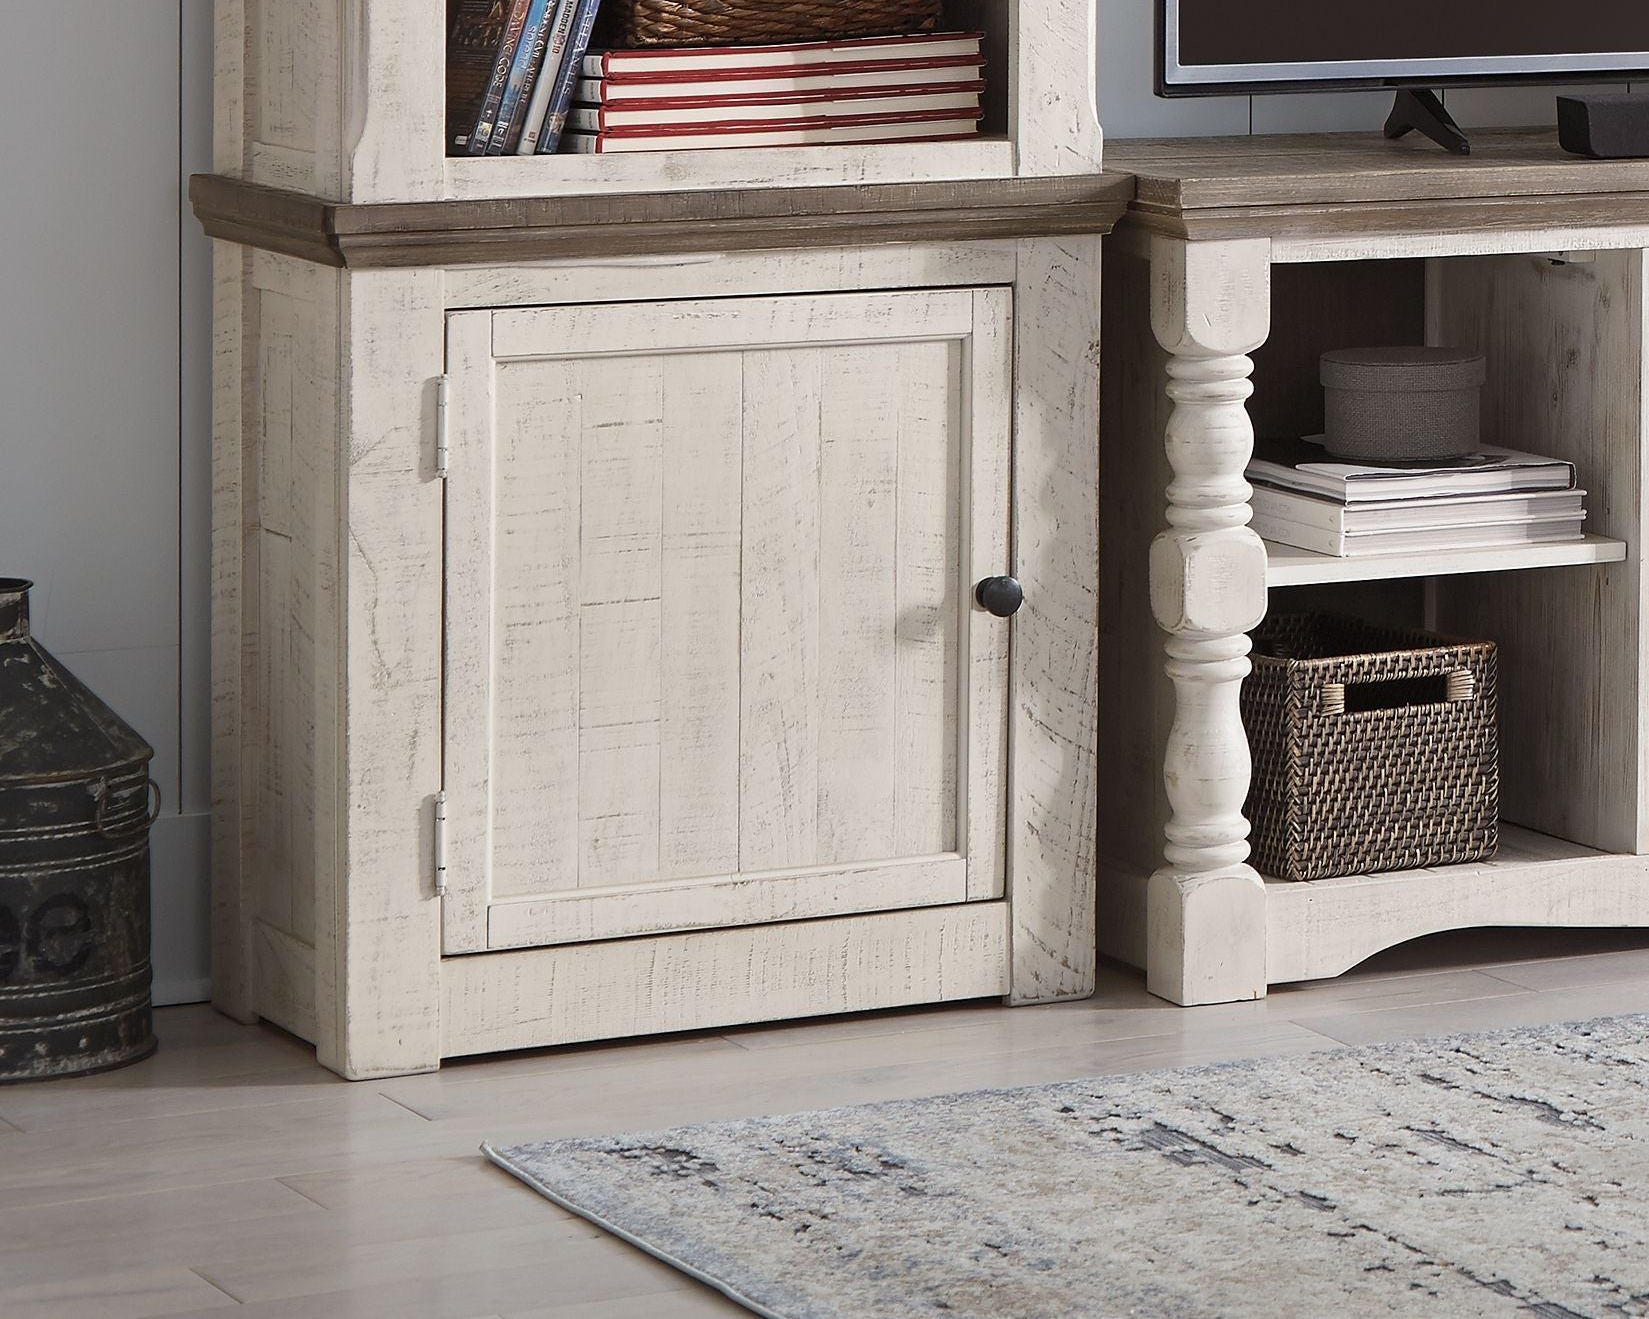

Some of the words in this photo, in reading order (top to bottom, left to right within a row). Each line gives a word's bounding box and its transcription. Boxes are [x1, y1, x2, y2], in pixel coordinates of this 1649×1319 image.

[558, 0, 573, 35] MADDEN
[564, 11, 593, 95] ATLANTIS
[493, 57, 509, 88] CODE
